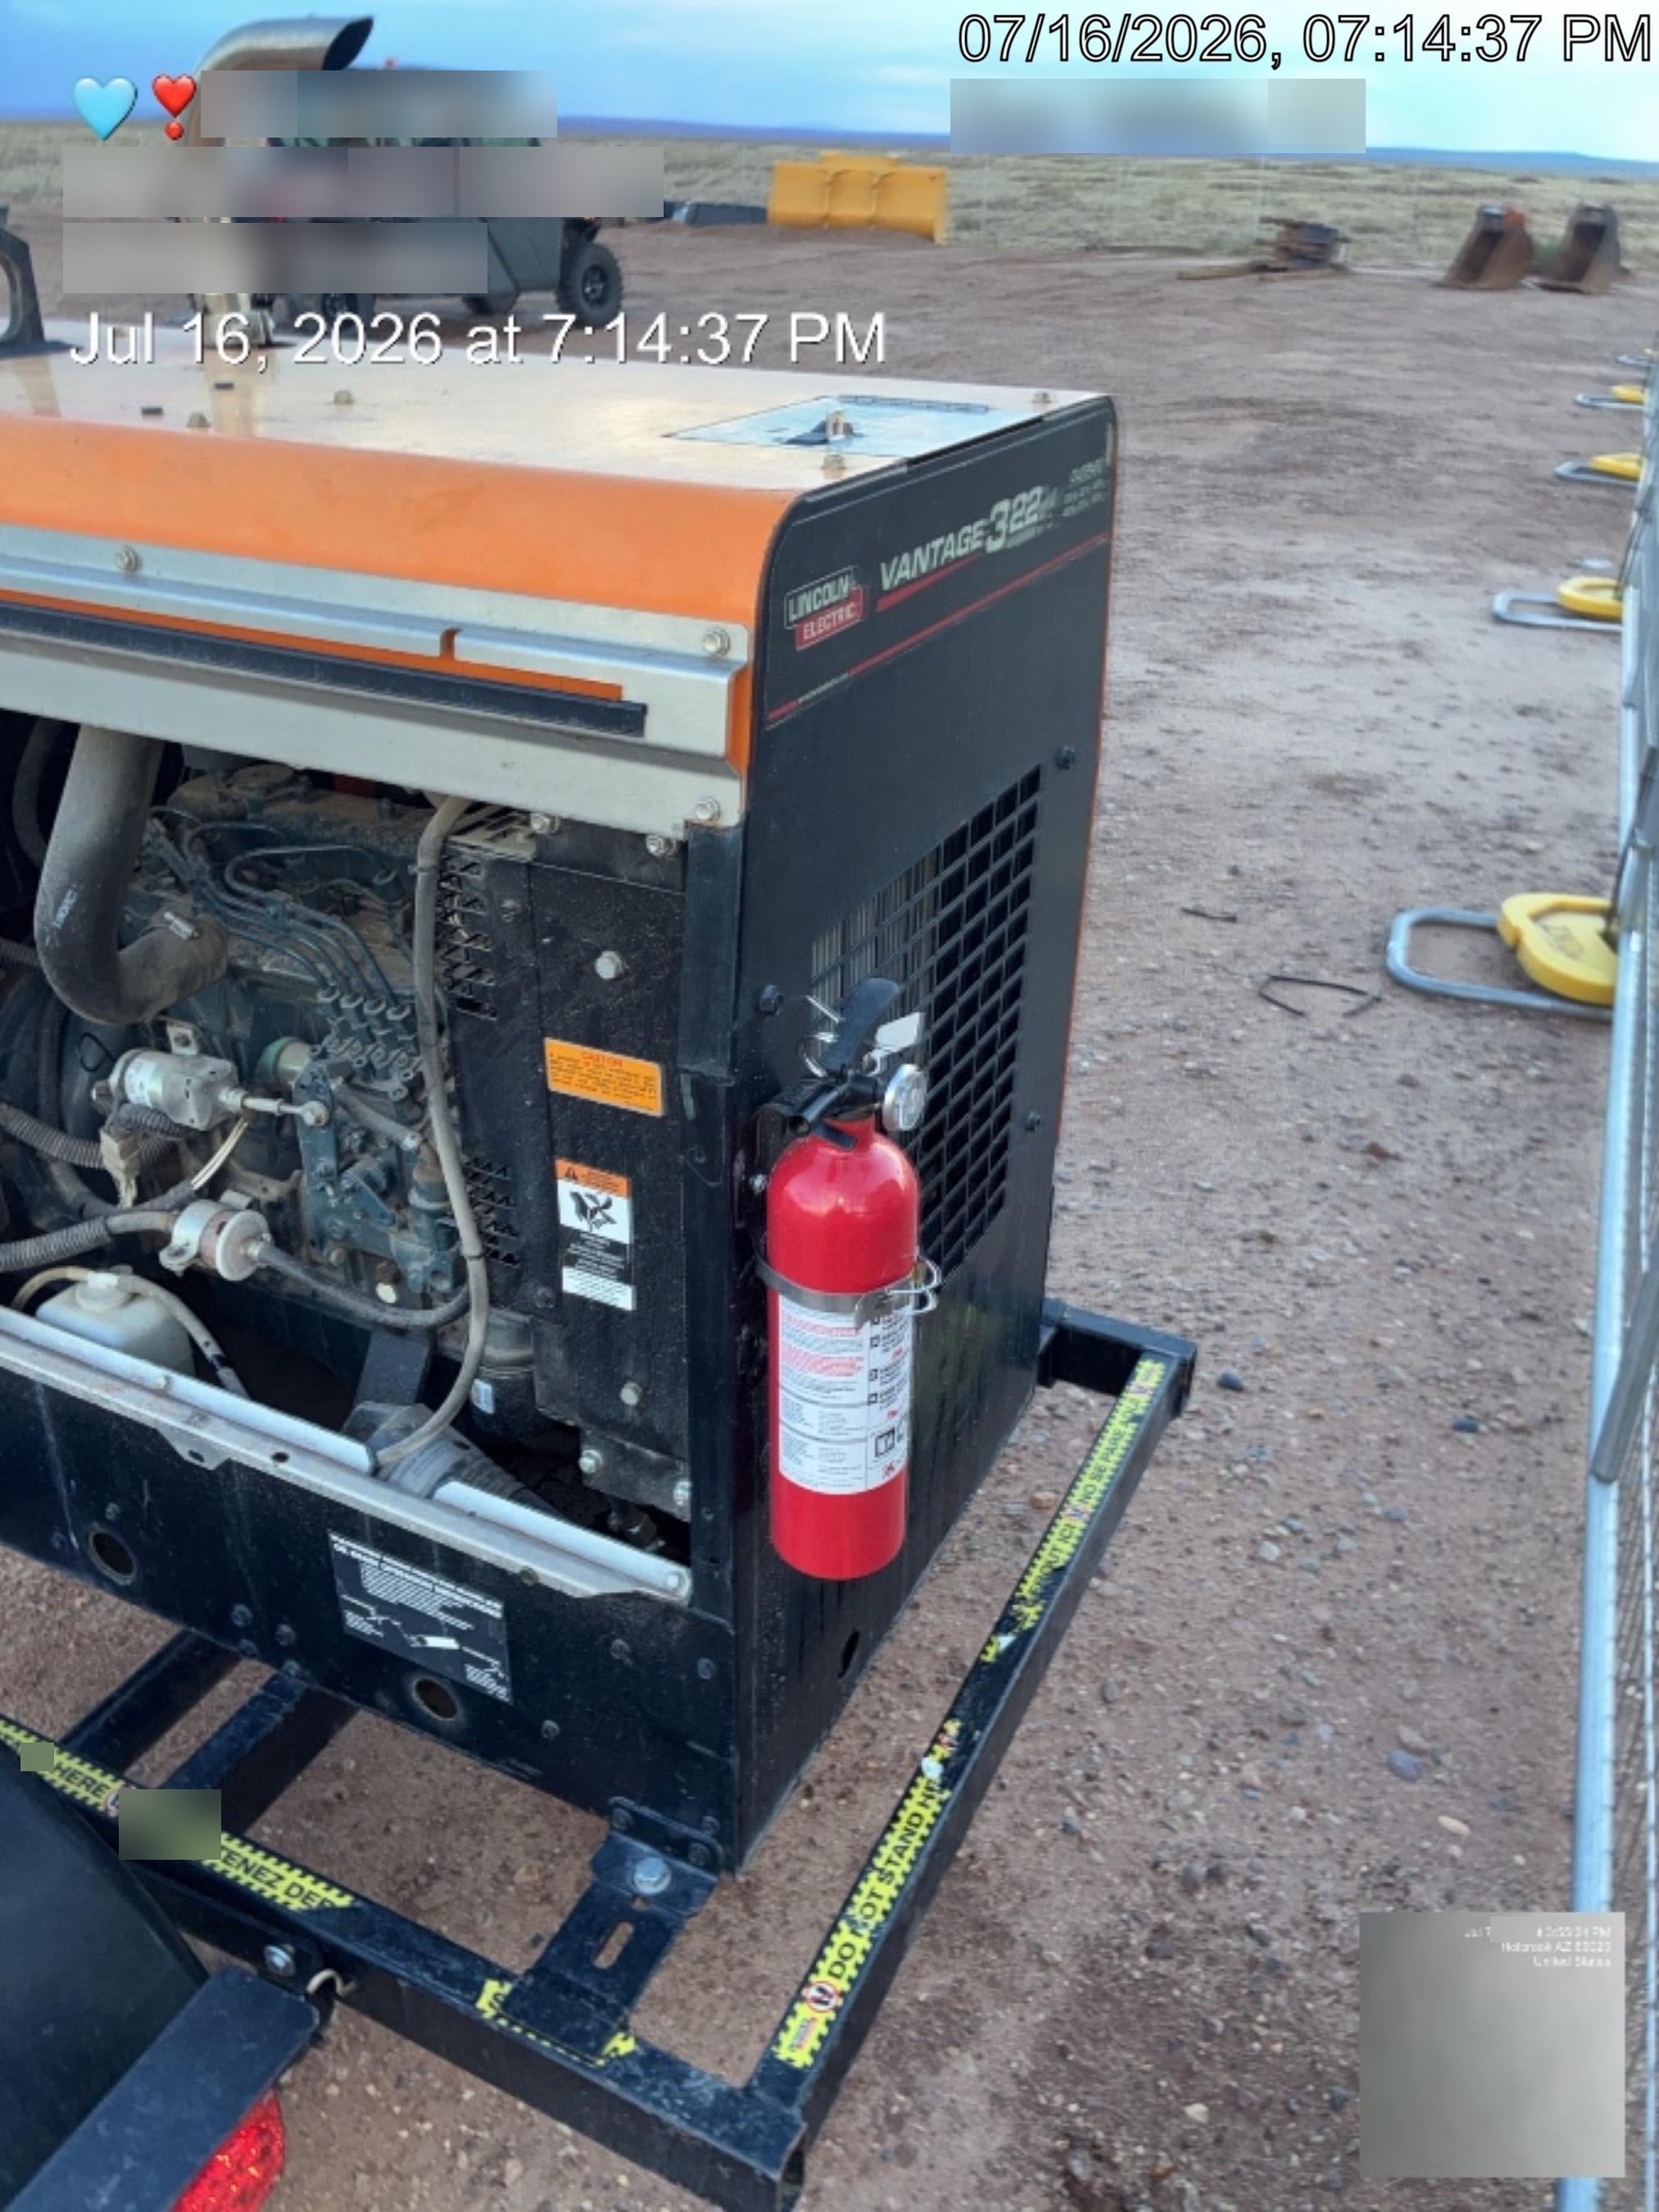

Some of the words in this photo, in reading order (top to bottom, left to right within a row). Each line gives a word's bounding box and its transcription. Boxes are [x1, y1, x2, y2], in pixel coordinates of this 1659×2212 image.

[880, 518, 989, 592] VANTAGE
[985, 485, 1044, 555] 322
[787, 573, 850, 623] LINCOLN
[803, 602, 857, 640] ELECTRIC
[827, 1942, 856, 1979] DO
[878, 1811, 925, 1885] STAND
